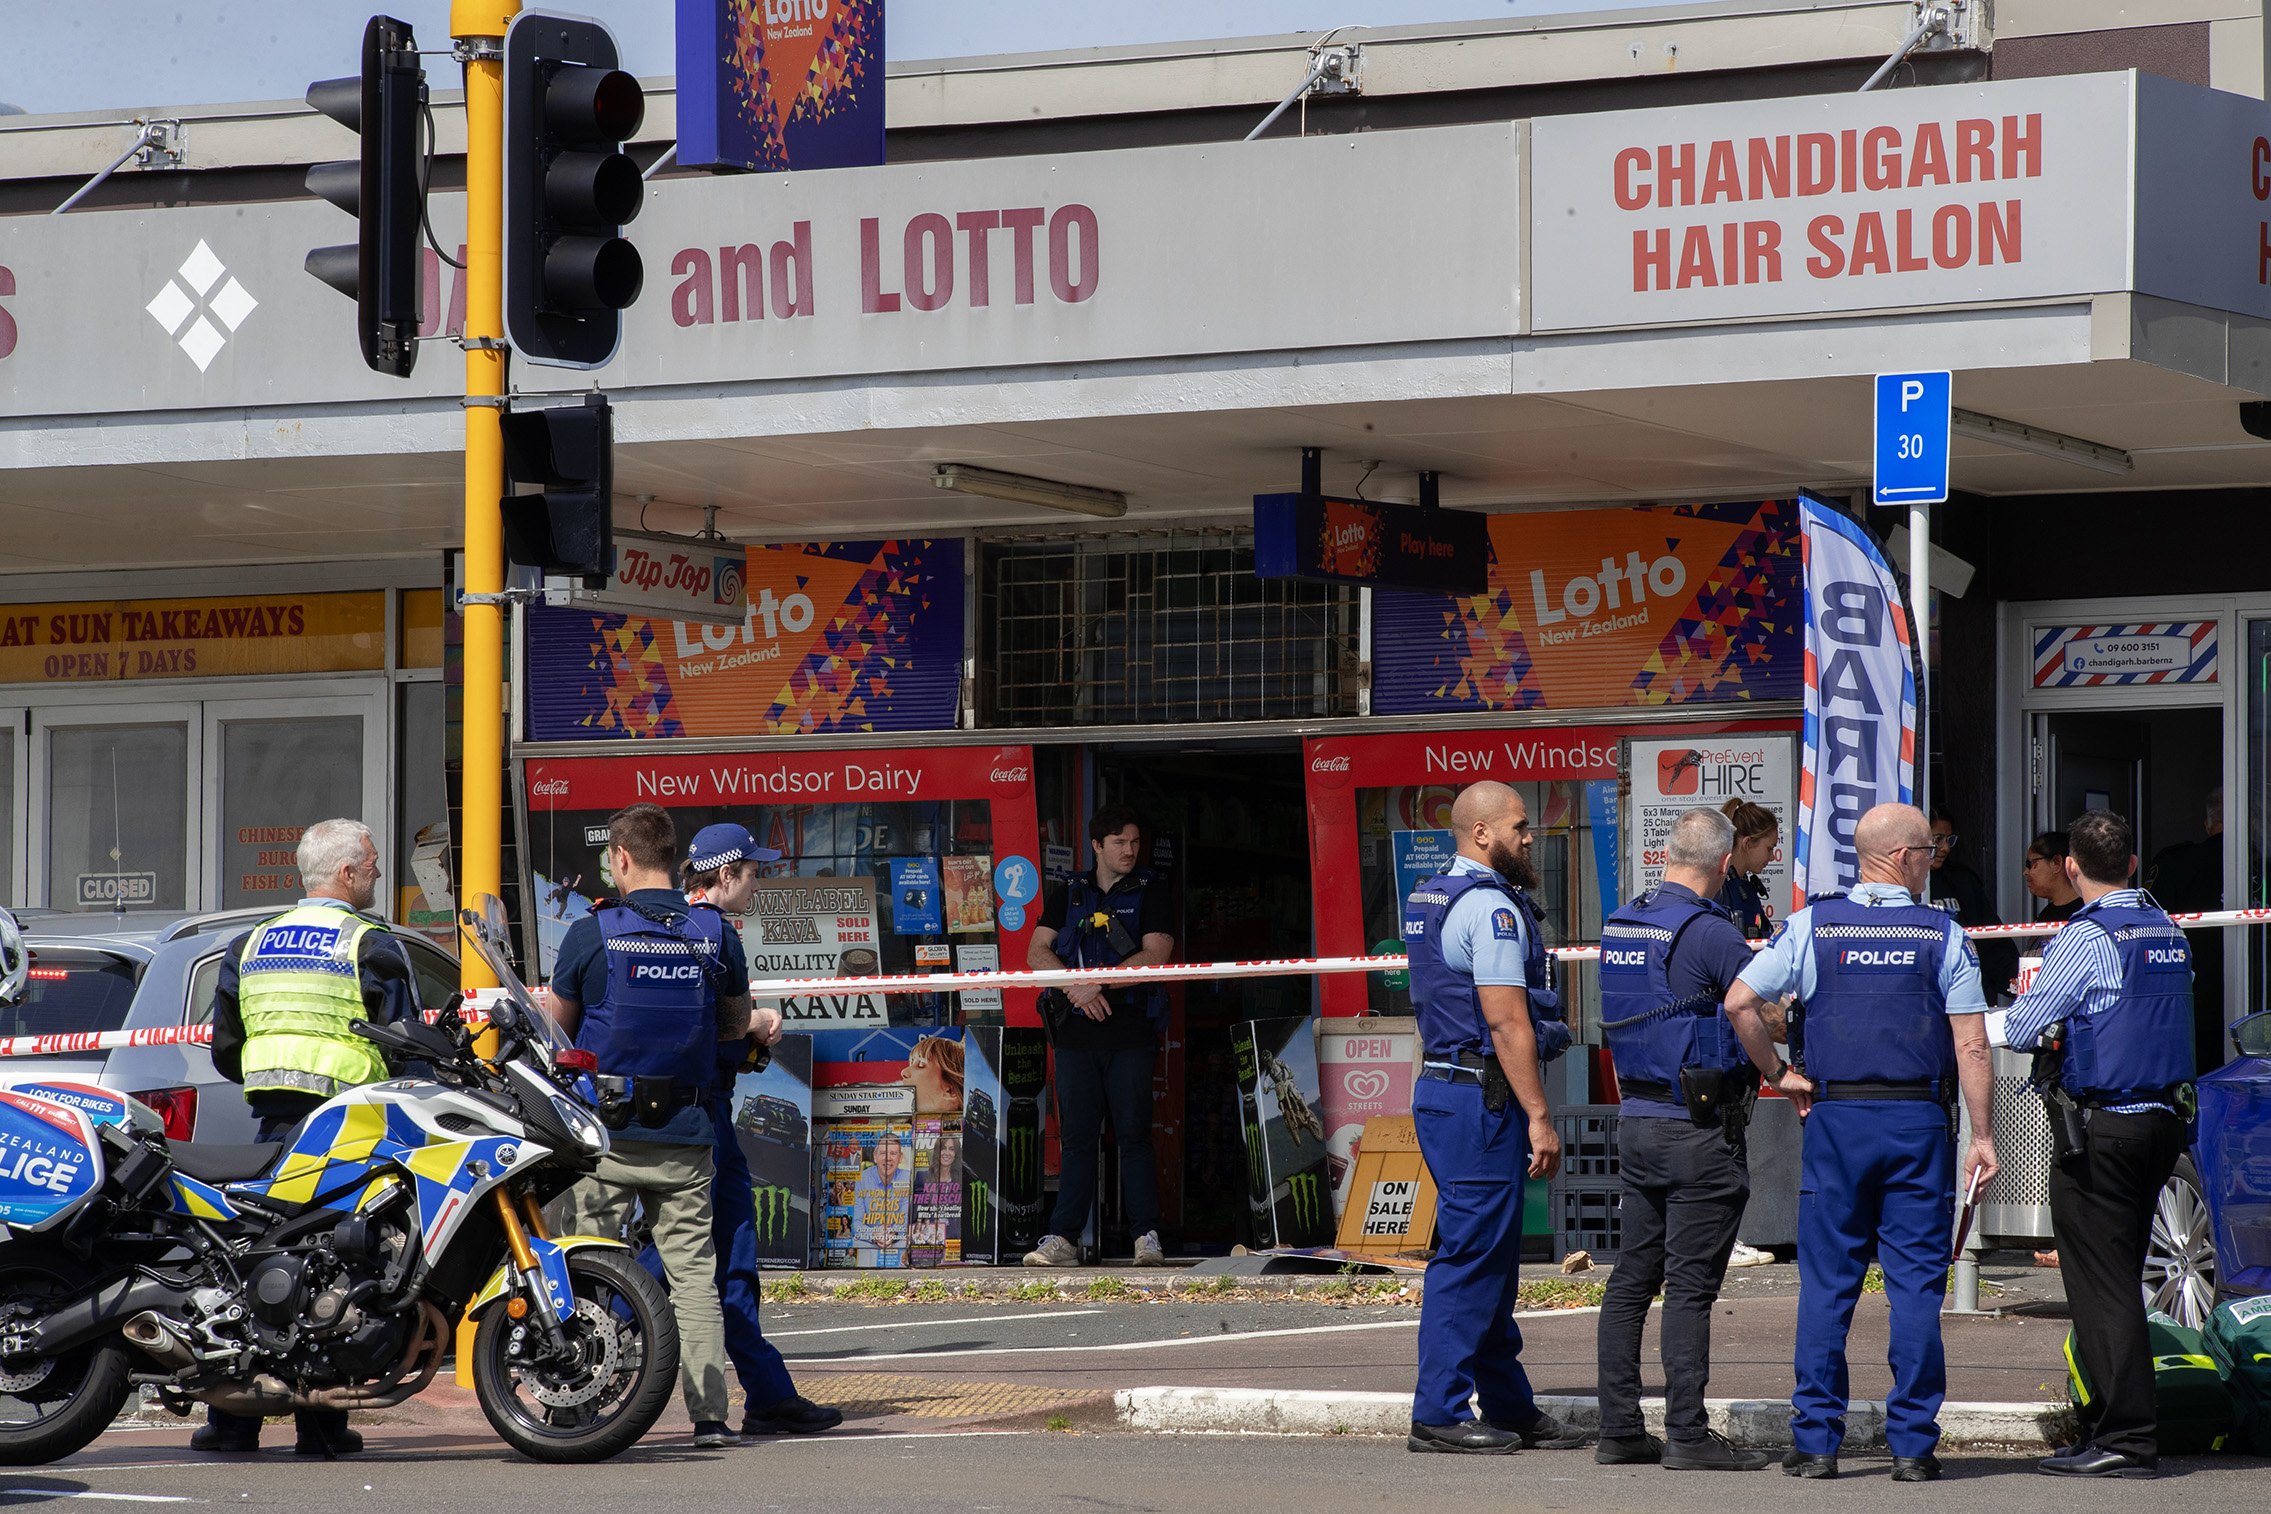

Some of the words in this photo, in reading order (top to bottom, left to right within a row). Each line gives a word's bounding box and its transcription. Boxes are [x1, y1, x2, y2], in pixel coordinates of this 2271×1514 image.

[767, 28, 783, 40] New
[785, 24, 813, 38] Zealand
[1613, 113, 2042, 211] CHANDIGARH
[1632, 220, 1782, 292] HAIR
[1807, 200, 2021, 279] SALON
[671, 221, 814, 327] and
[860, 204, 1099, 314] LOTTO
[1901, 381, 1924, 412] P
[1897, 434, 1924, 460] 30
[1335, 523, 1365, 546] Lotto
[1401, 533, 1425, 560] Play
[1429, 536, 1454, 558] here
[619, 548, 662, 591] Tip
[664, 554, 711, 597] Top
[1530, 551, 1686, 628] Lotto
[51, 613, 112, 645] SUN
[122, 605, 305, 642] TAKEAWAYS
[673, 588, 814, 658] Lotto
[1539, 627, 1577, 648] New
[1581, 608, 1649, 639] Zealand
[2107, 644, 2119, 652] 09
[2121, 643, 2139, 652] 600
[2141, 643, 2160, 651] 3151
[45, 652, 110, 678] OPEN
[118, 651, 130, 676] 7
[138, 648, 197, 674] DAYS
[679, 660, 714, 679] New
[718, 642, 781, 671] Zealand
[2088, 657, 2173, 668] chandigarh.barbernz
[1311, 757, 1350, 772] Coca-Cola
[1425, 746, 1493, 772] New
[1504, 741, 1617, 769] Windso
[1702, 749, 1764, 763] PreEvent
[636, 770, 700, 796] New
[710, 765, 834, 794] Windsor
[845, 763, 922, 794] Dairy
[1702, 764, 1764, 795] HIRE
[1643, 808, 1657, 817] 6x3
[587, 829, 609, 842] GRA
[1643, 829, 1648, 837] 3
[1643, 839, 1664, 848] Light
[257, 851, 299, 866] BURG
[1643, 851, 1665, 866] $25
[83, 878, 150, 899] CLOSED
[241, 874, 278, 891] FISH
[283, 874, 294, 889] &
[796, 887, 869, 914] LABEL
[762, 917, 821, 944] KAVA
[837, 918, 869, 928] SOLD
[838, 932, 870, 942] HERE
[260, 927, 336, 951] POLICE
[755, 954, 837, 972] QUALITY
[1606, 950, 1646, 965] POLICE
[1846, 951, 1916, 965] POLICE
[636, 966, 699, 979] POLICE
[779, 994, 881, 1019] KAVA
[1004, 1042, 1044, 1056] Unleash
[1346, 1039, 1392, 1058] OPEN
[1017, 1058, 1032, 1069] the
[29, 1088, 57, 1103] LOOK
[58, 1094, 80, 1106] FOR
[80, 1098, 114, 1112] BIKES
[829, 1092, 858, 1100] SUNDAY
[881, 1091, 904, 1099] TIMES
[16, 1098, 30, 1108] CALL
[29, 1103, 46, 1115] 111
[843, 1105, 870, 1113] SUNDAY
[1347, 1102, 1382, 1110] STREETS
[858, 1190, 869, 1198] AT
[869, 1189, 891, 1198] HOME
[923, 1183, 946, 1193] KATE
[948, 1182, 960, 1192] TO
[1383, 1183, 1408, 1195] ON
[869, 1199, 900, 1211] CHRIS
[914, 1194, 929, 1204] THE
[931, 1194, 962, 1204] RESCU
[1369, 1202, 1413, 1215] SALE
[862, 1212, 905, 1225] HIPKINS
[1362, 1222, 1409, 1235] HERE
